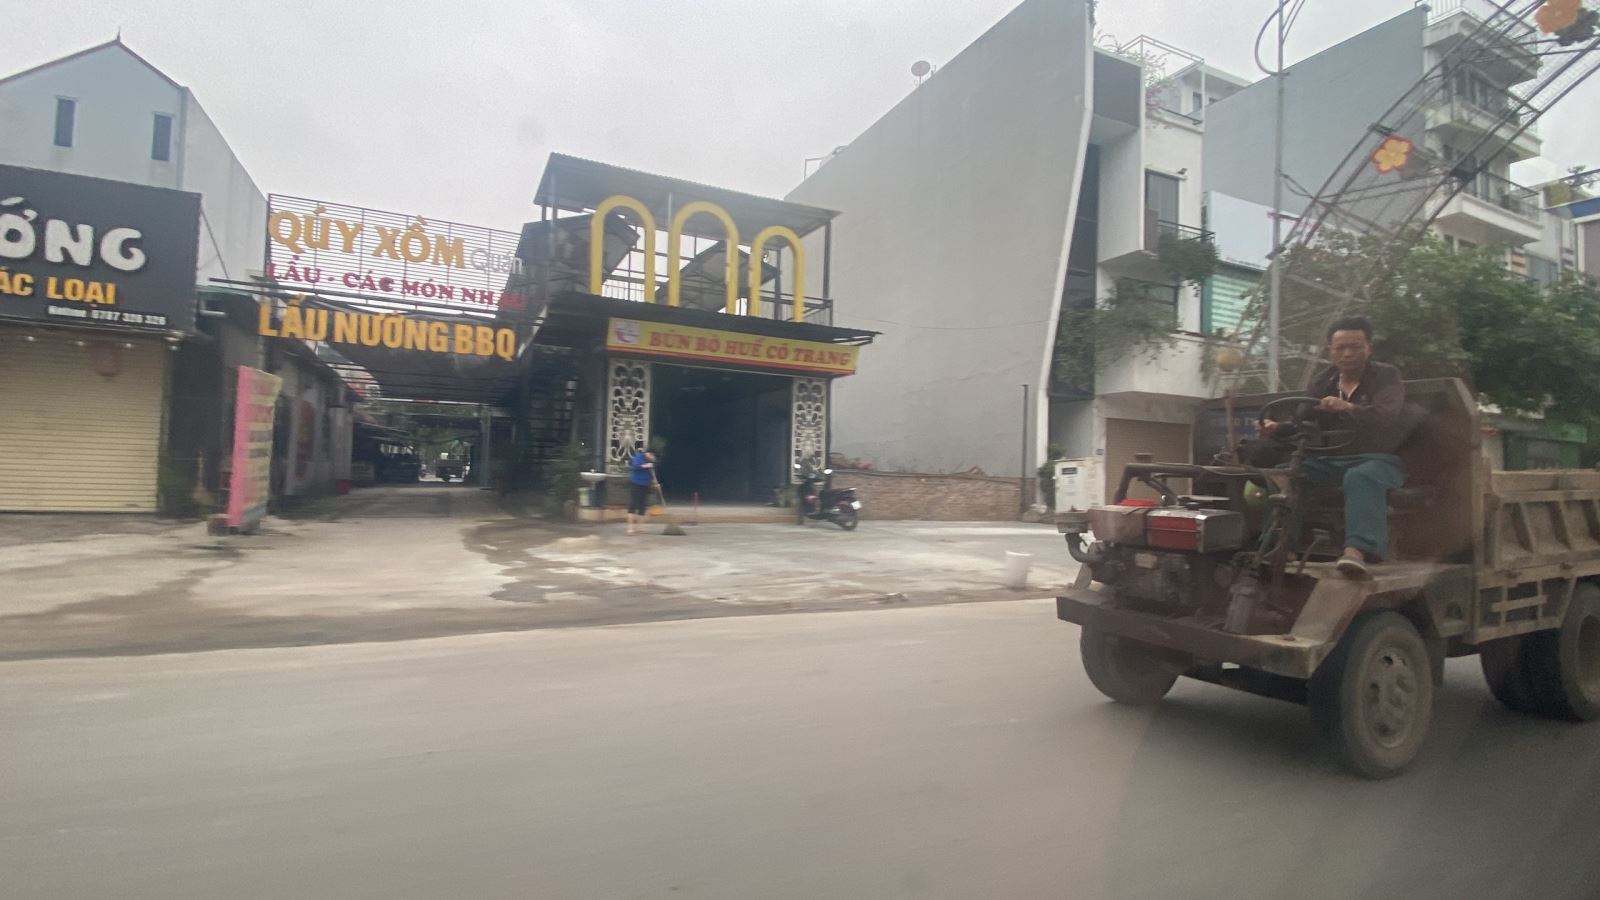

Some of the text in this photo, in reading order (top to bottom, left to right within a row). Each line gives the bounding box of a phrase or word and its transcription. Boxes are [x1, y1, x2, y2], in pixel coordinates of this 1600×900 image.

[371, 214, 465, 268] XỒM
[47, 276, 116, 308] LOẠI
[342, 270, 394, 292] CÁC
[401, 278, 455, 300] MÓN
[461, 287, 528, 311] NH
[334, 310, 449, 352] NƯỚNG
[454, 323, 516, 361] BBQ
[648, 329, 690, 349] BÚN
[695, 334, 721, 353] BÒ
[725, 337, 765, 357] HUẾ
[794, 347, 851, 366] TRANG
